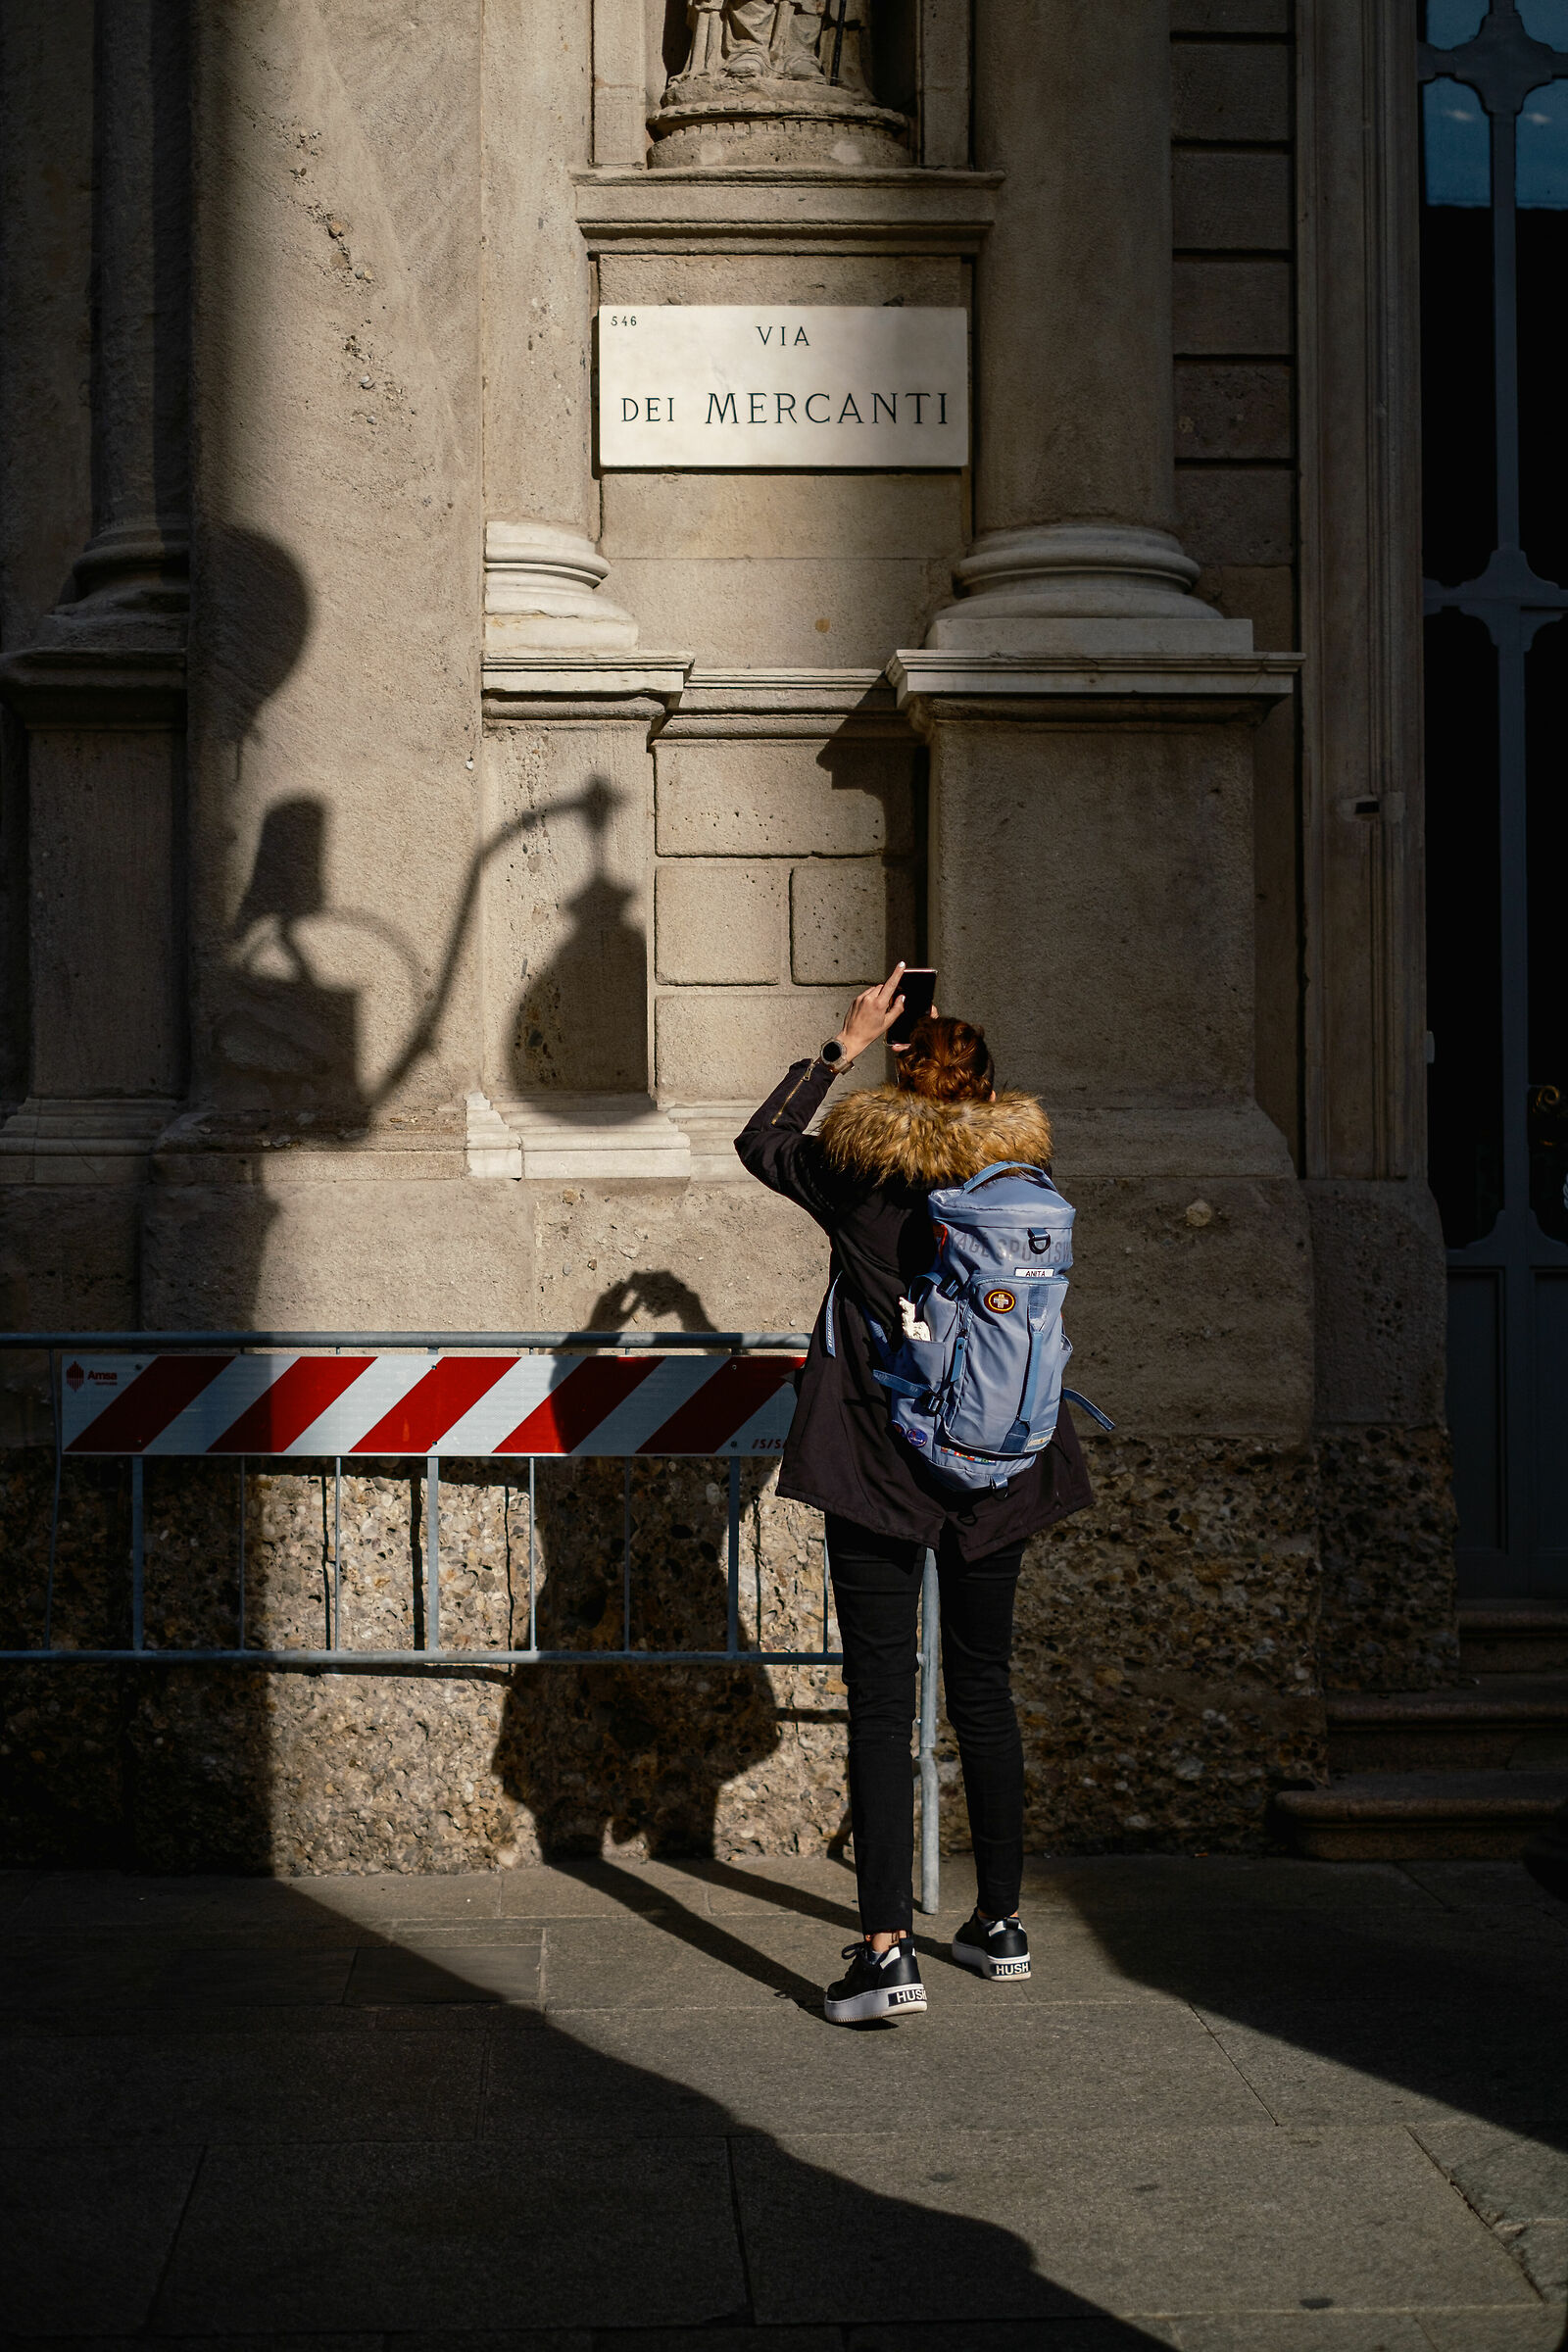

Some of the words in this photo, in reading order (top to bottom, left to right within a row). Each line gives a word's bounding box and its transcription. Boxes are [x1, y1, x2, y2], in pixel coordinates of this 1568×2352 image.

[756, 325, 811, 347] VIA
[620, 397, 675, 422] DEI
[705, 392, 948, 424] MERCANTI
[87, 1370, 118, 1381] Amsa
[996, 1962, 1029, 1976] HUSH
